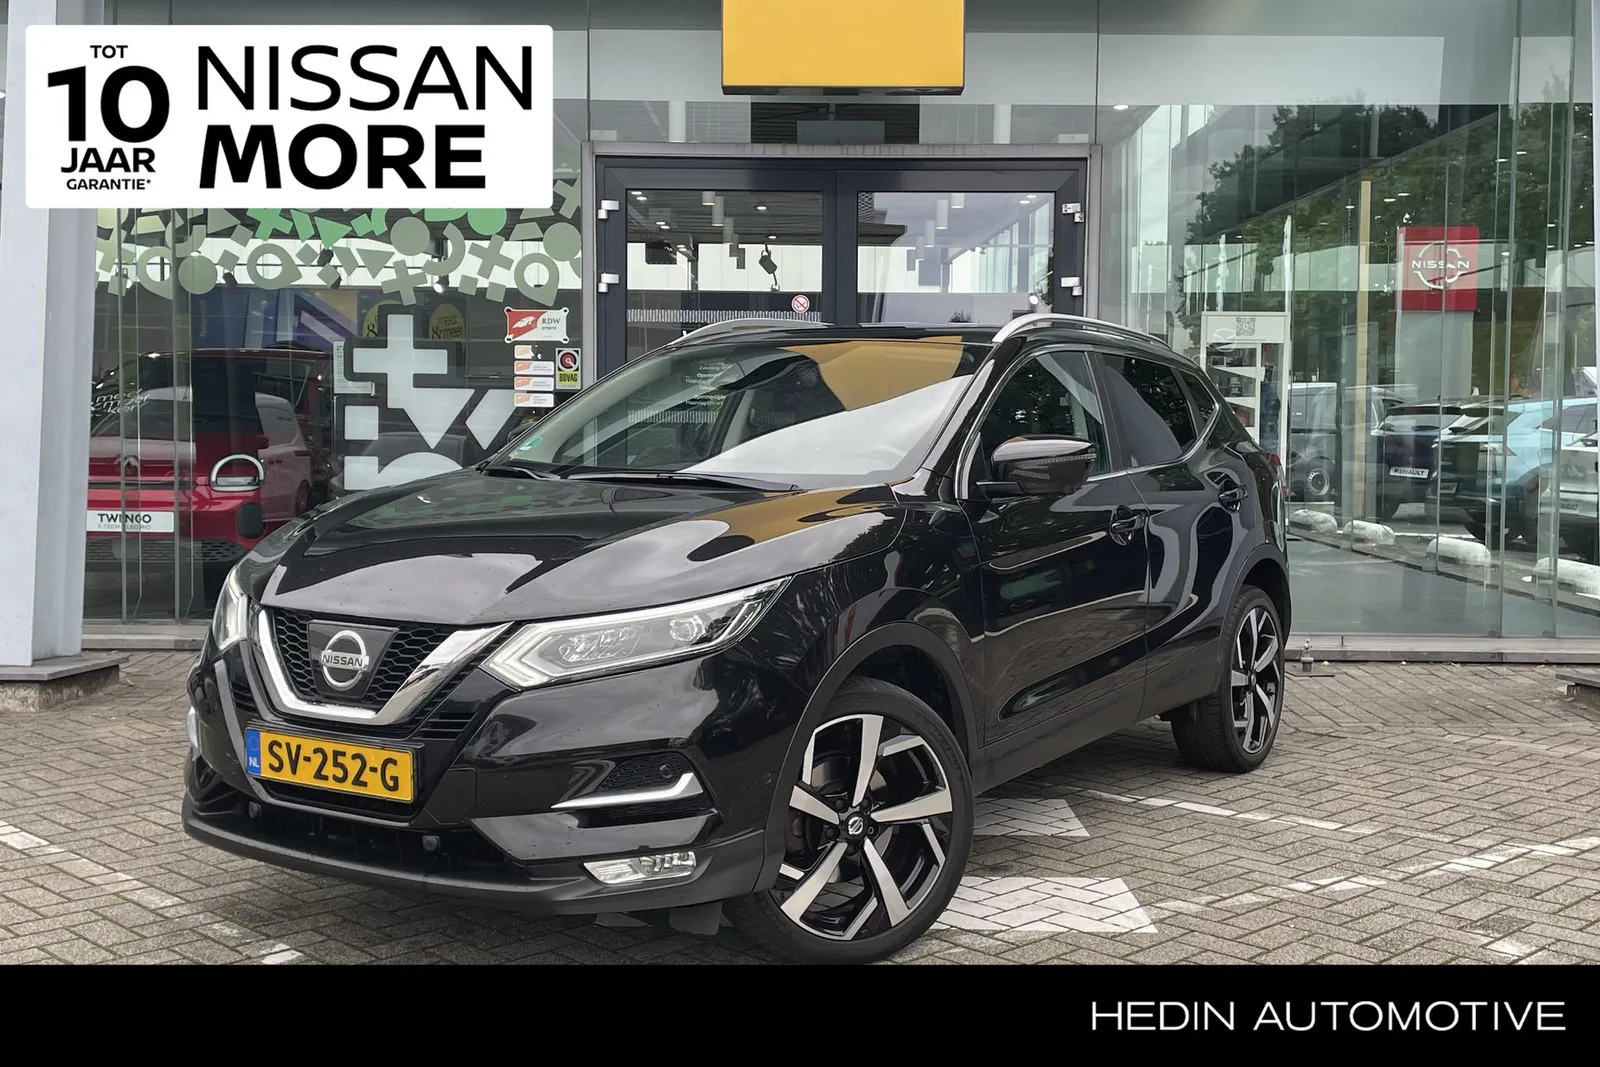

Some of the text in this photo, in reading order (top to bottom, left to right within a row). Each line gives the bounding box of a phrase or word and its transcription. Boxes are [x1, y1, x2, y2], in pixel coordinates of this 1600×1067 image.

[1411, 260, 1470, 269] NISSAN
[541, 317, 561, 325] RDW
[559, 372, 578, 383] BOVAG
[1394, 468, 1425, 476] RENAULT
[97, 513, 152, 523] TWINGO
[322, 654, 363, 667] NISSAN
[248, 740, 399, 792] NL SV-252-G
